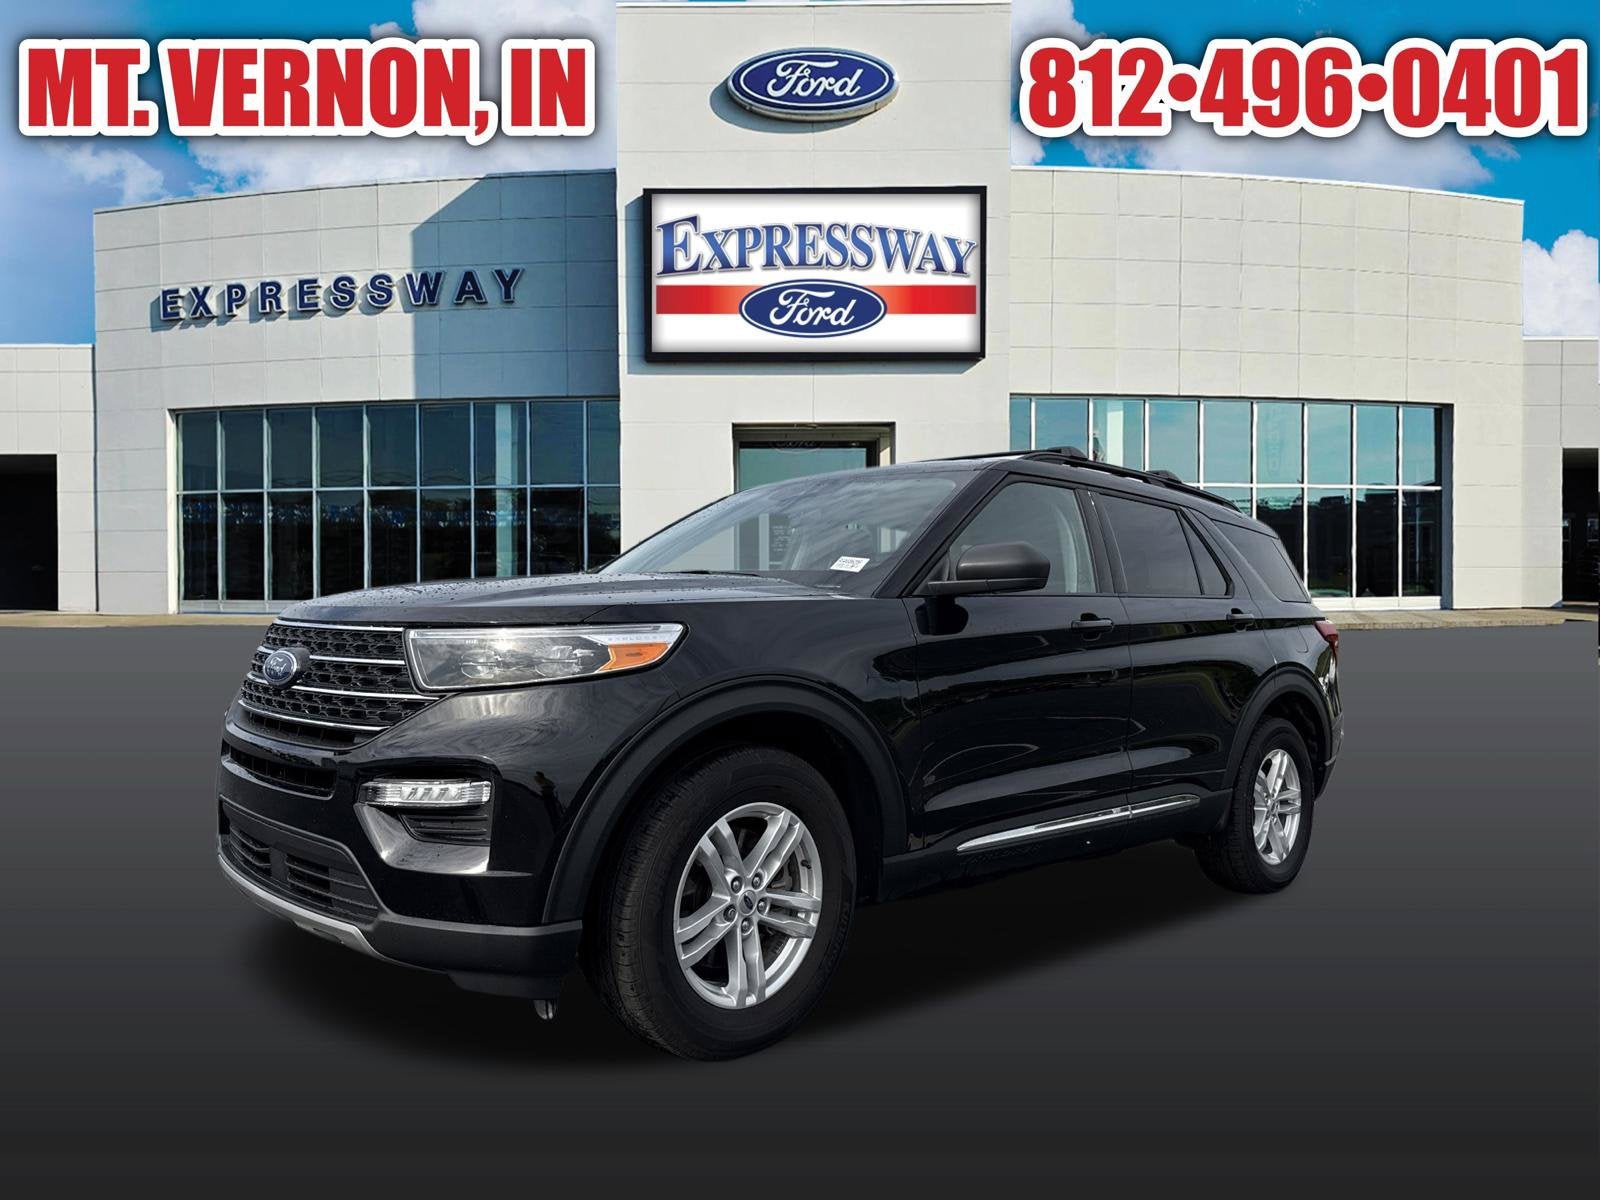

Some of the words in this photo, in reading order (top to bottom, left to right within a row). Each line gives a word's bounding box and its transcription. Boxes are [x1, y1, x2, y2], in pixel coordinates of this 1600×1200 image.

[766, 60, 864, 97] Ford
[160, 268, 524, 321] EXPRESSWAY
[769, 288, 857, 326] Ford
